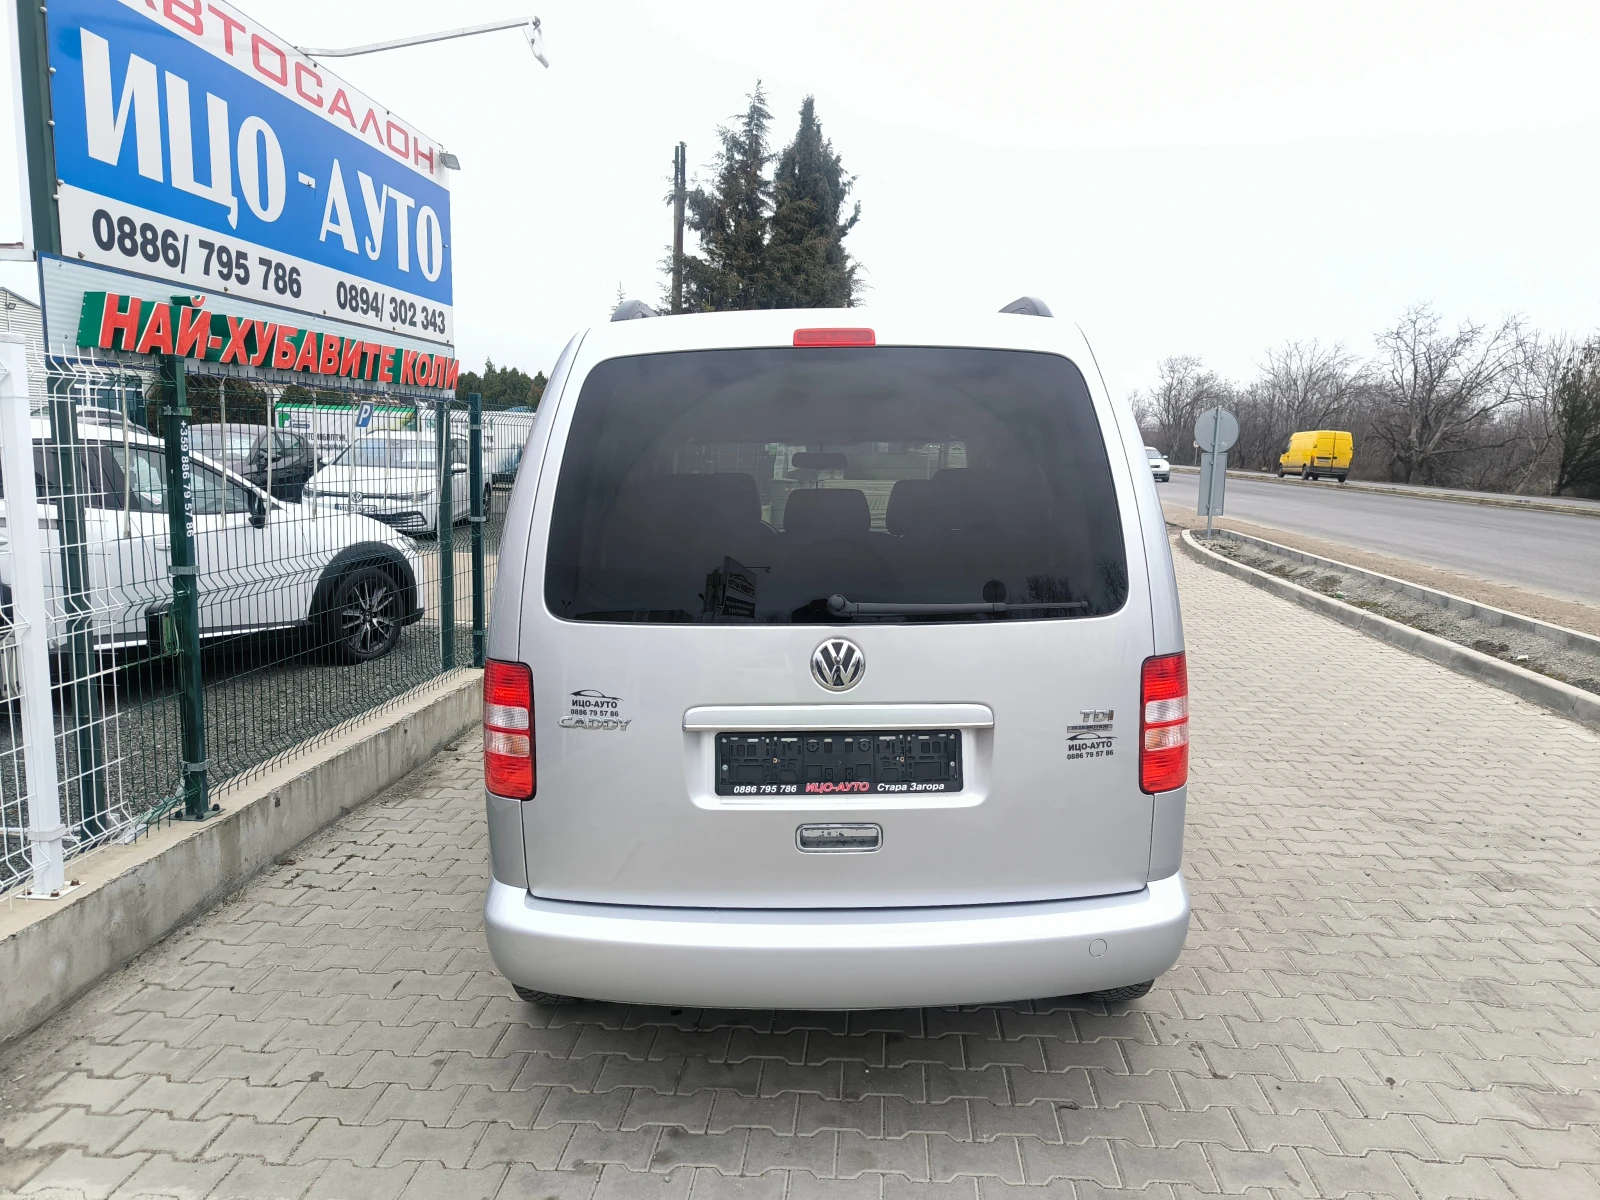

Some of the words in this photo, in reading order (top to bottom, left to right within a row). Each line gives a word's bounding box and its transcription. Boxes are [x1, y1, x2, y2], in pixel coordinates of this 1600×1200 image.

[145, 0, 435, 174] ВТОСАЛОН
[92, 208, 189, 274] 0886/
[198, 239, 250, 286] 795
[258, 257, 302, 299] 786
[336, 281, 385, 322] 0894/
[389, 296, 417, 328] 302
[421, 306, 446, 334] 343
[98, 292, 396, 383] НАЙ-ХУБАВИТЕ
[400, 349, 460, 390] КОЛИ
[180, 420, 189, 452] +359
[181, 456, 190, 479] 886
[183, 482, 192, 498] 79
[184, 503, 194, 519] 57
[186, 522, 194, 538] 86
[572, 699, 618, 709] ИЦО-АУТО
[1080, 708, 1114, 722] TDI
[558, 716, 633, 731] CADDY
[1068, 740, 1112, 752] ИЦО-АУТО
[734, 785, 758, 794] 0886
[760, 785, 778, 793] 795
[780, 784, 797, 793] 786
[805, 782, 870, 793] ИЦО-АУТО
[877, 782, 908, 792] Стара
[910, 782, 945, 792] Загора
